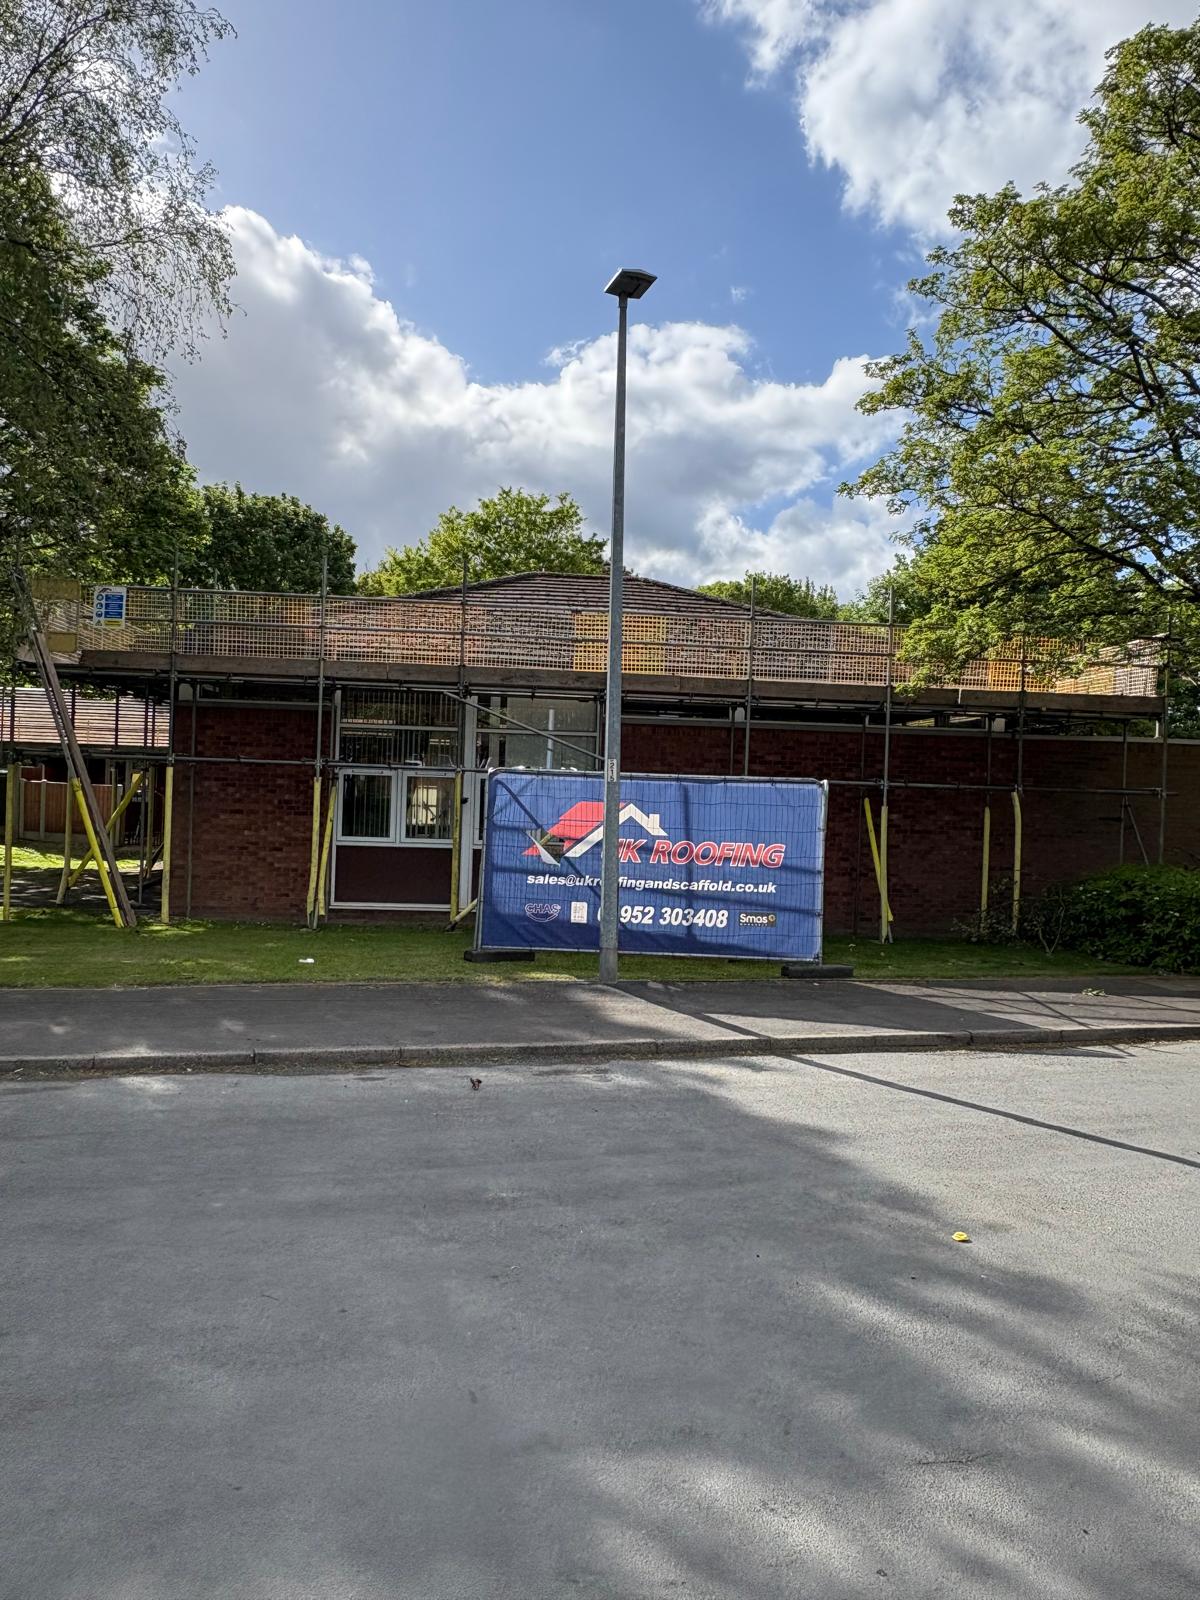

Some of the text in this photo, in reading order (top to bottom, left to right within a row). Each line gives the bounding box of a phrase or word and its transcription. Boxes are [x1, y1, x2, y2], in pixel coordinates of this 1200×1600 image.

[650, 839, 786, 868] ROOFING
[526, 874, 777, 894] sales@ukrfingandscaffold.co.uk
[525, 903, 561, 914] CHAS
[597, 905, 655, 925] 952
[659, 907, 729, 928] 303408
